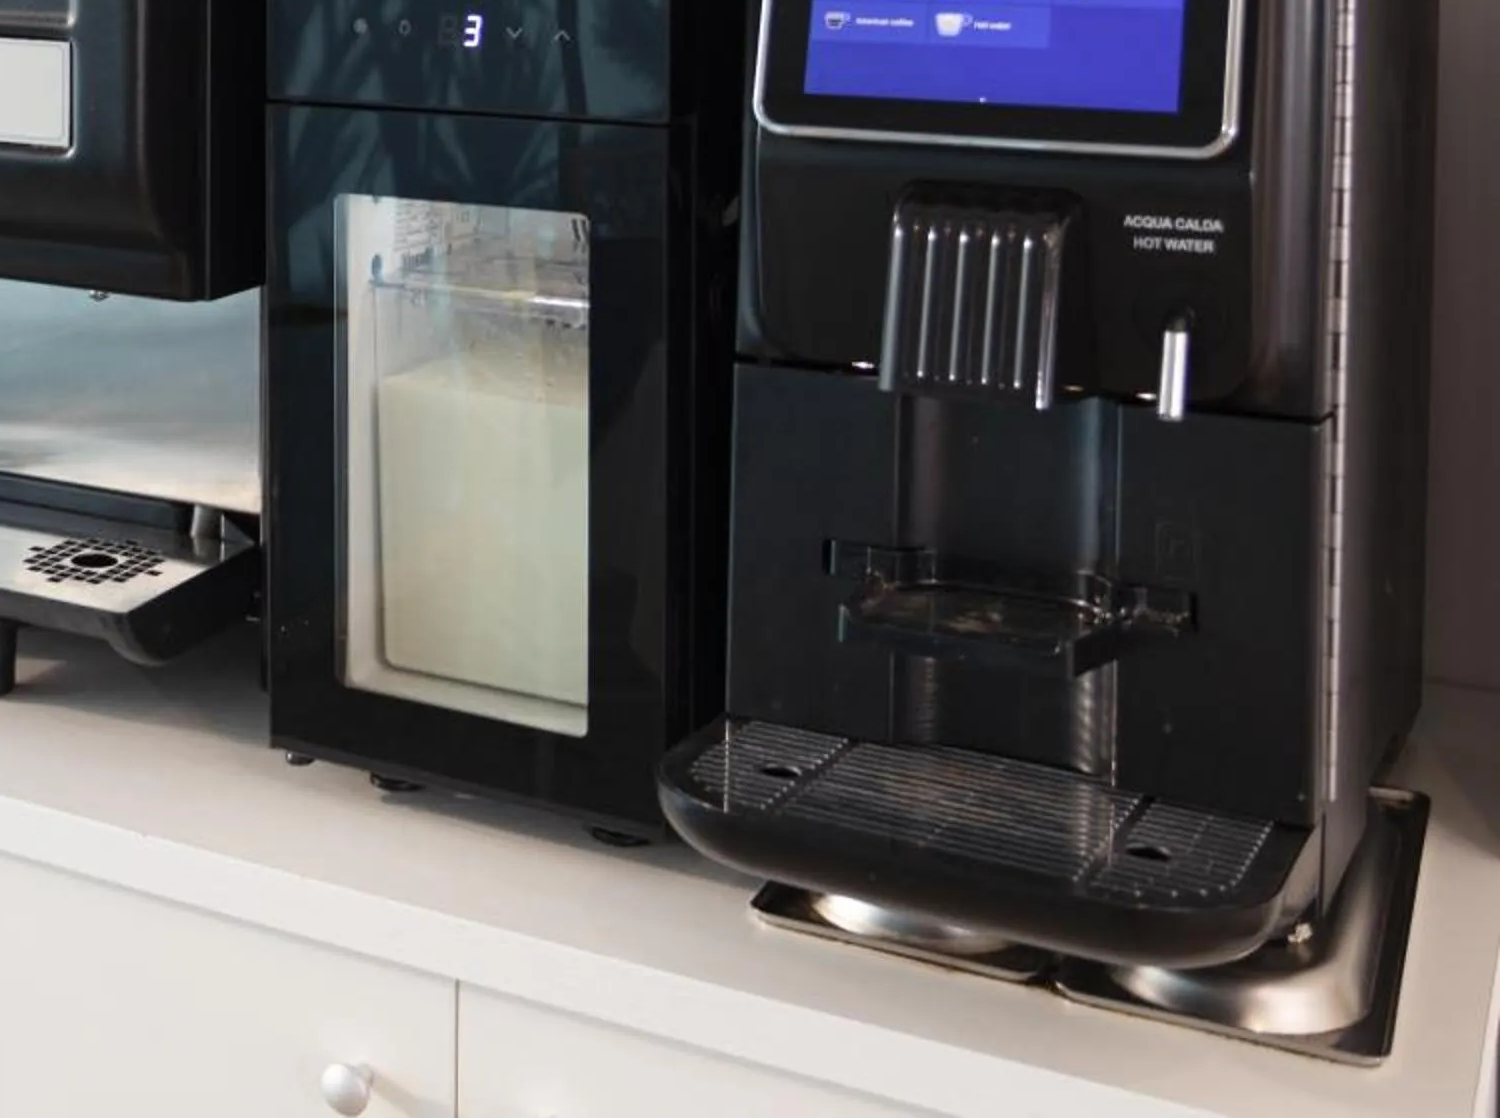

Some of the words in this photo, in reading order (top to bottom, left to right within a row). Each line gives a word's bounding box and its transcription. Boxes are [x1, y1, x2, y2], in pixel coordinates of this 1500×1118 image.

[463, 13, 484, 47] 3
[1124, 215, 1173, 231] ACQUA
[1174, 217, 1224, 233] CALDA
[1133, 236, 1162, 251] HOT
[1164, 237, 1215, 253] WATER
